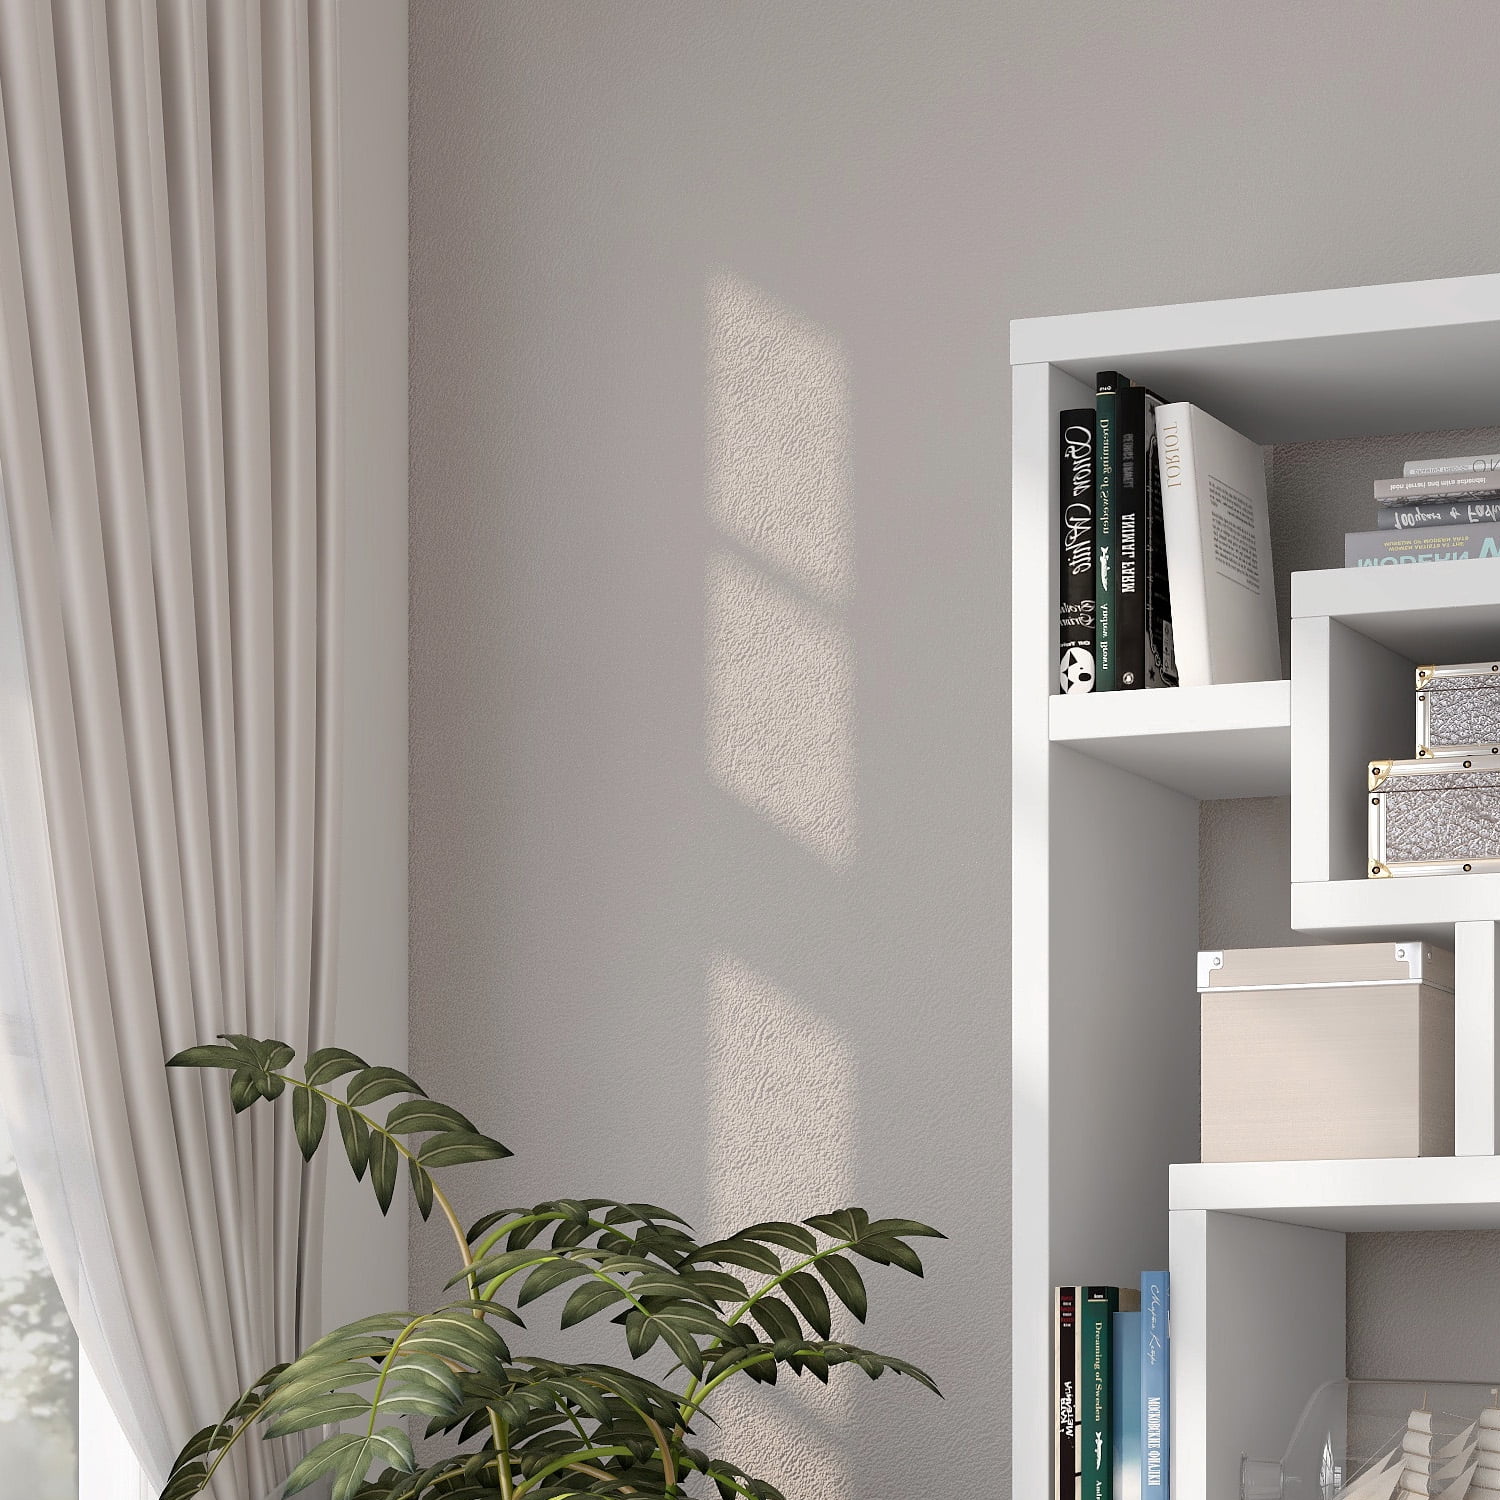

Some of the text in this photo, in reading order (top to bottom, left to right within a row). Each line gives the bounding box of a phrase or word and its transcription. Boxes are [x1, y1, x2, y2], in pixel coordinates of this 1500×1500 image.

[1094, 1322, 1103, 1422] Dreaming of Sweden
